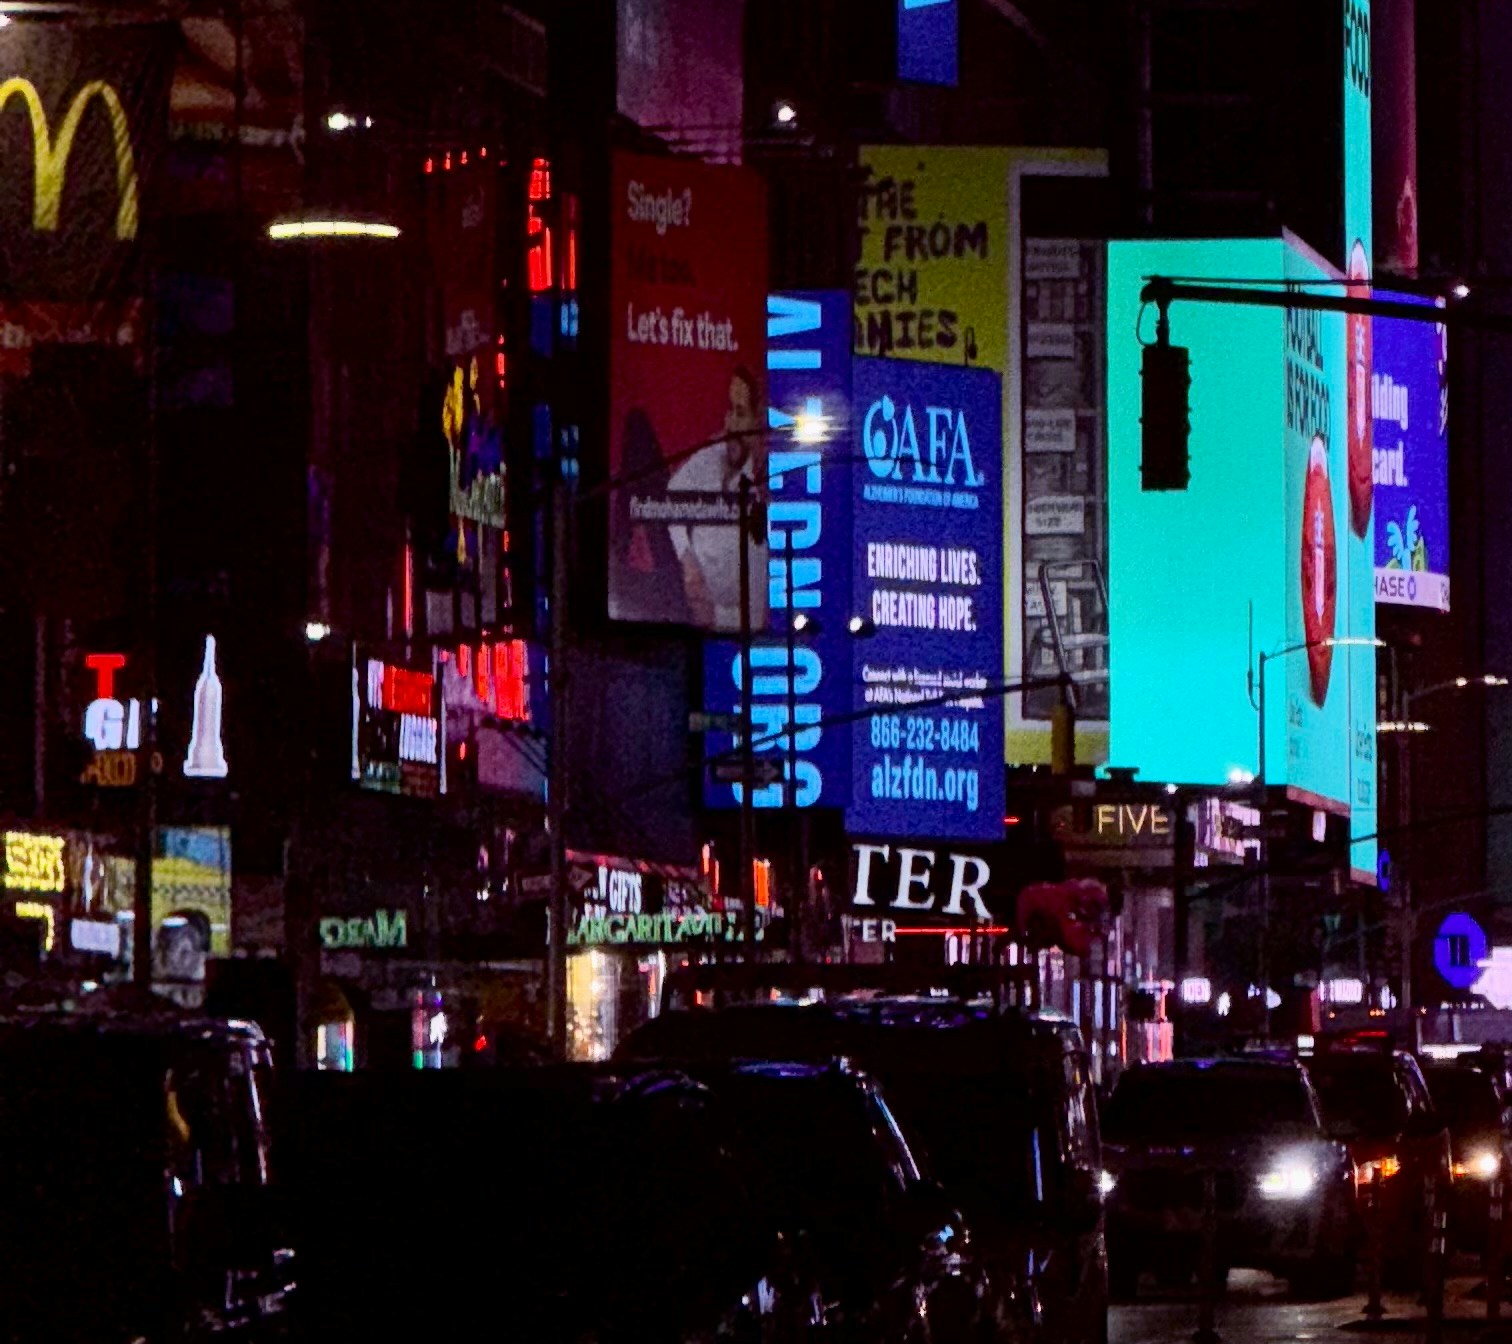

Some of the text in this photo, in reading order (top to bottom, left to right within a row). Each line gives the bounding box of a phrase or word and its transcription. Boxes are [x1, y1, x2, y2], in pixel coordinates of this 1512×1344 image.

[627, 179, 693, 236] Single?
[884, 221, 988, 263] FROM
[627, 302, 740, 353] Let's fix that.
[867, 542, 982, 586] ENRICHING LIVES.
[872, 589, 977, 632] CREATING HOPE.
[871, 713, 979, 753] 866-232-8484
[871, 754, 979, 812] alzfdn.org
[1097, 803, 1170, 835] FIVE
[609, 868, 642, 914] GIFTS
